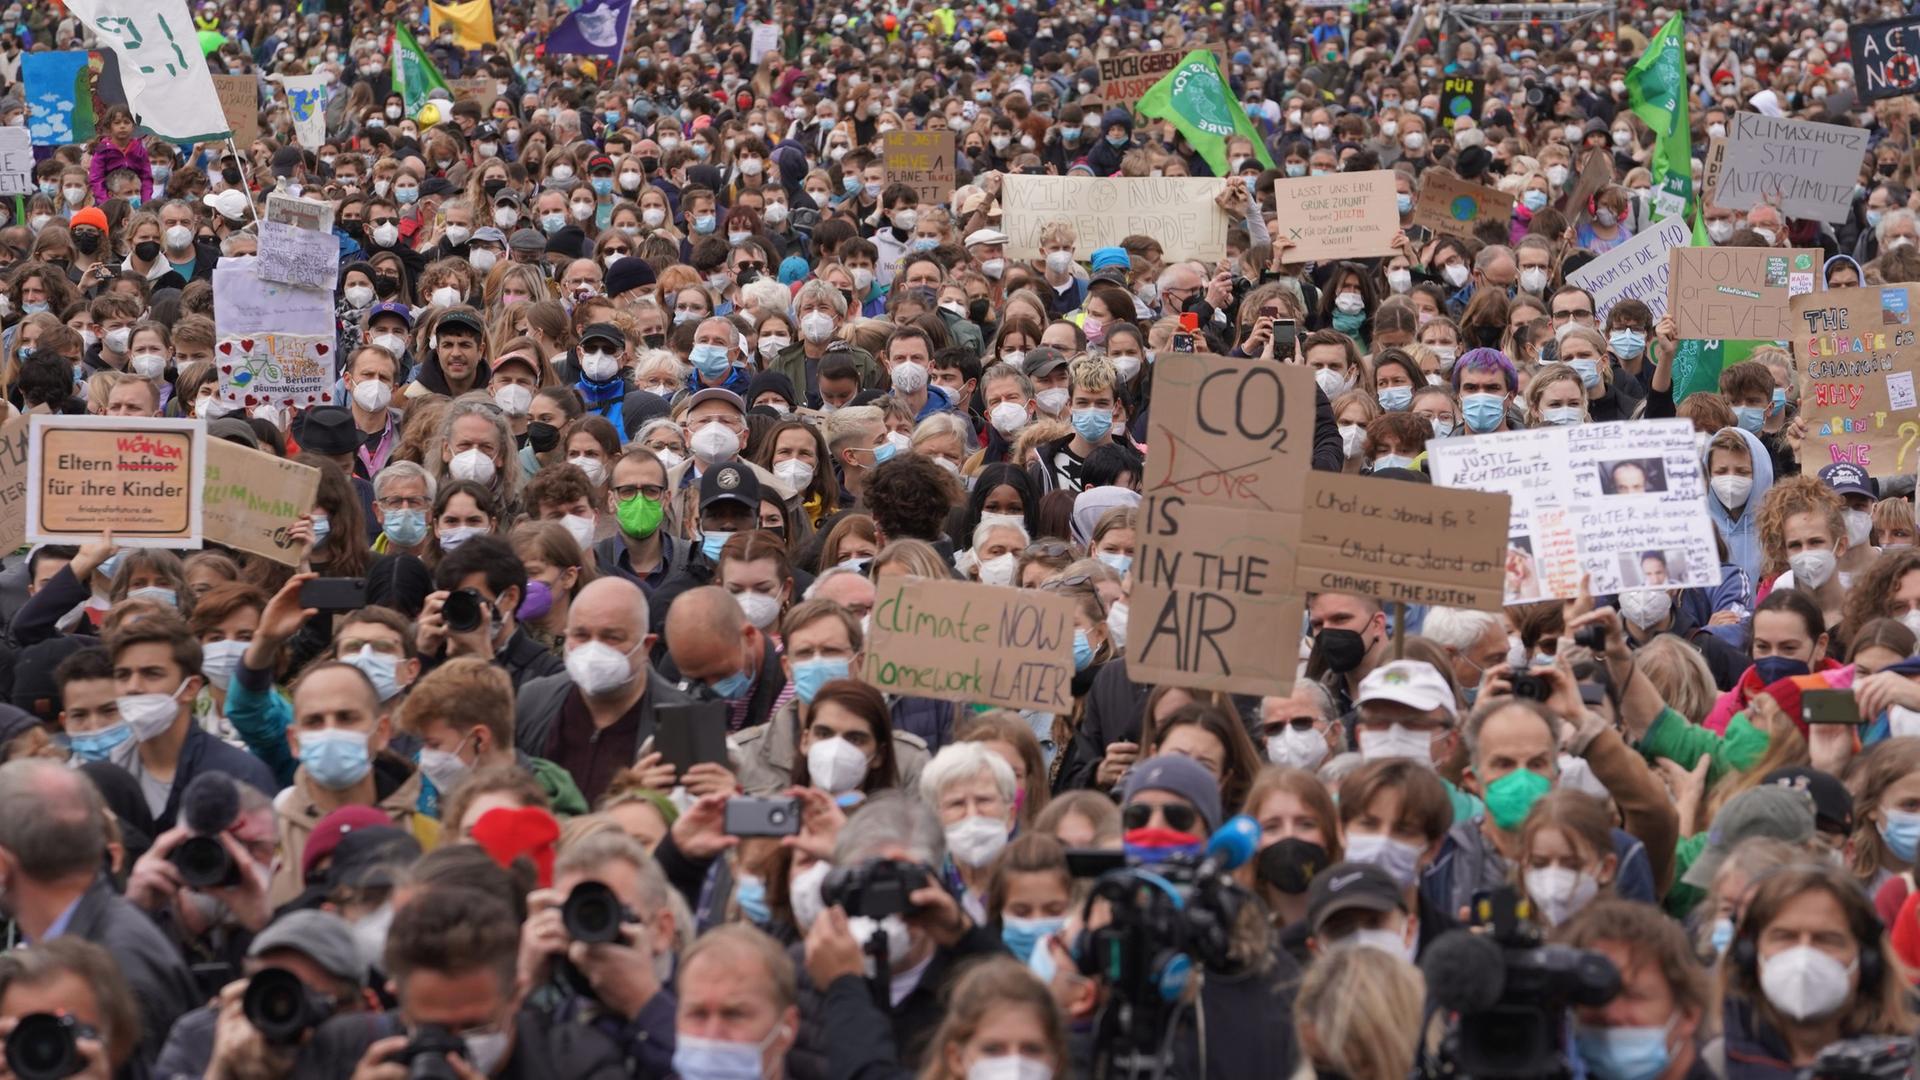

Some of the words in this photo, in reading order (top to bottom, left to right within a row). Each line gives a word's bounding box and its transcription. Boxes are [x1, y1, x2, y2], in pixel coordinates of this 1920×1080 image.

[1102, 57, 1139, 80] EUCH
[1445, 78, 1474, 94] FÜR
[1738, 113, 1860, 150] KLIMASCHUTZ
[1761, 143, 1823, 167] STATT
[1007, 180, 1082, 211] WIR
[1128, 179, 1189, 208] NUR
[1291, 185, 1323, 198] LASST
[1329, 184, 1348, 194] UNS
[1353, 182, 1374, 193] EINE
[1717, 167, 1854, 205] AUTOSCHMUTZ
[1332, 196, 1369, 208] ZUKUNFT
[1328, 225, 1353, 235] ZUKUNFT
[1576, 267, 1620, 293] WARUM
[1618, 256, 1633, 274] IST
[1635, 244, 1658, 265] DIE
[1680, 252, 1763, 284] NOW
[1682, 286, 1709, 299] or
[1680, 305, 1793, 337] NEVER
[1804, 308, 1849, 333] THE
[253, 384, 322, 393] BäumeWässerer
[286, 376, 321, 384] Berliner
[1815, 383, 1865, 409] WHY
[1568, 424, 1622, 439] FOLTER
[117, 434, 182, 461] wählen
[1829, 444, 1871, 466] WE
[58, 454, 112, 471] Eltern
[119, 454, 175, 472] haften
[1462, 452, 1521, 473] JUSTIZ
[48, 478, 73, 496] für
[82, 480, 116, 496] ihre
[123, 481, 183, 497] Kinder
[1147, 496, 1185, 536] IS
[1582, 507, 1638, 527] FOLTER
[1340, 538, 1385, 562] What
[1418, 548, 1464, 571] stand
[1138, 544, 1182, 590] IN
[1193, 552, 1269, 595] THE
[1321, 572, 1381, 596] CHANGE
[1389, 582, 1424, 598] THE
[1426, 588, 1477, 604] SYSTEM
[999, 601, 1065, 650] NOW
[1139, 590, 1236, 677] AIR
[866, 652, 983, 693] homework
[990, 658, 1067, 707] LATER
